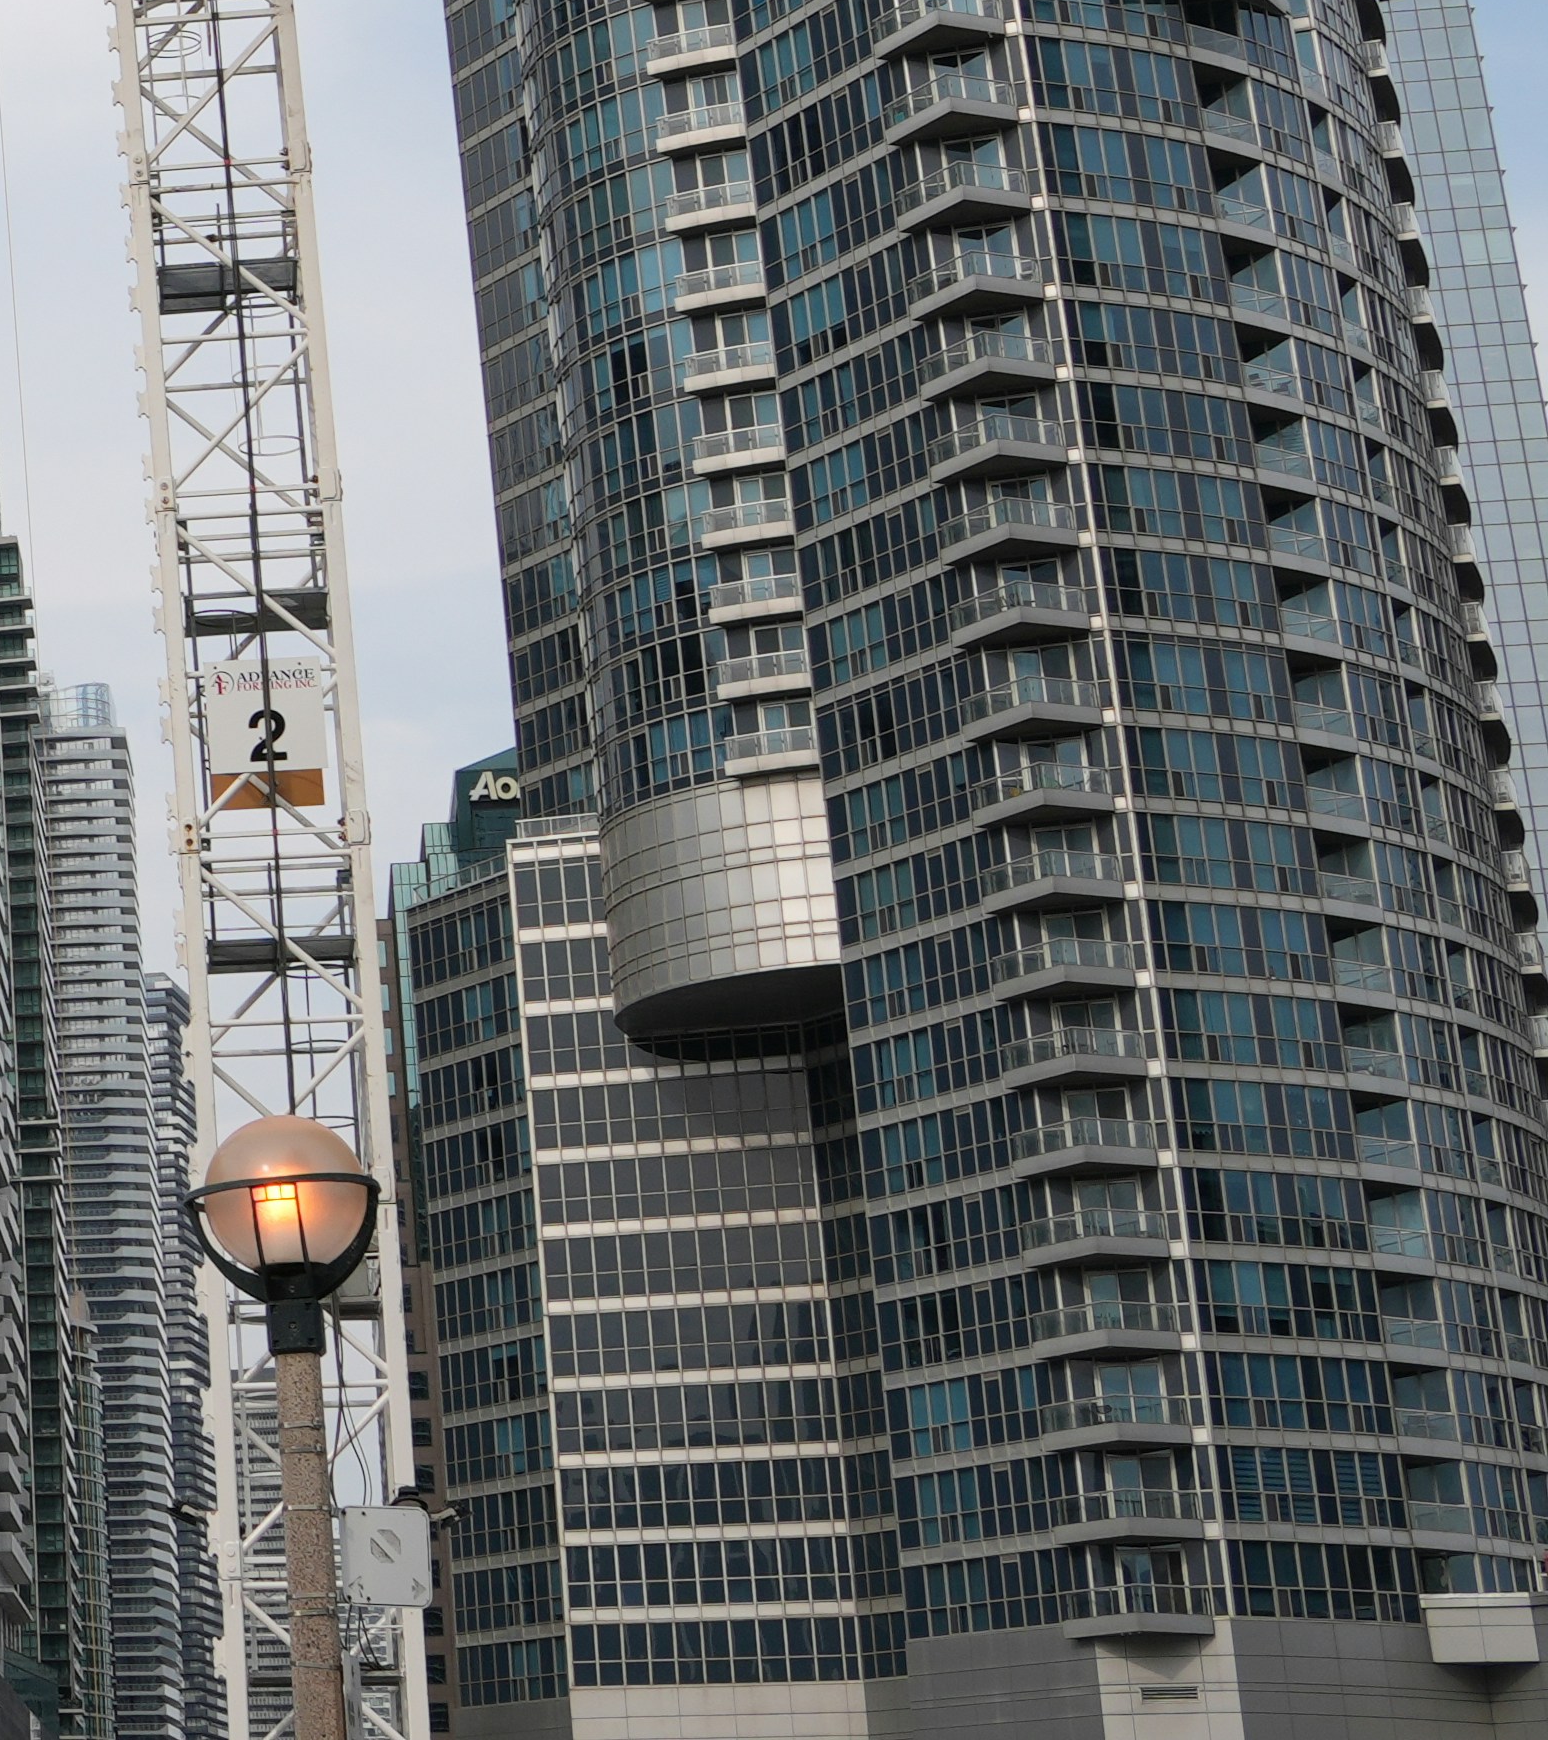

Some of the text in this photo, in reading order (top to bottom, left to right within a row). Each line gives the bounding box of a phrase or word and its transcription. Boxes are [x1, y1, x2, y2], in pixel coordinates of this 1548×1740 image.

[237, 668, 315, 683] ADANCE
[237, 680, 292, 692] FORING
[248, 709, 288, 762] 2
[469, 771, 520, 801] Ao
